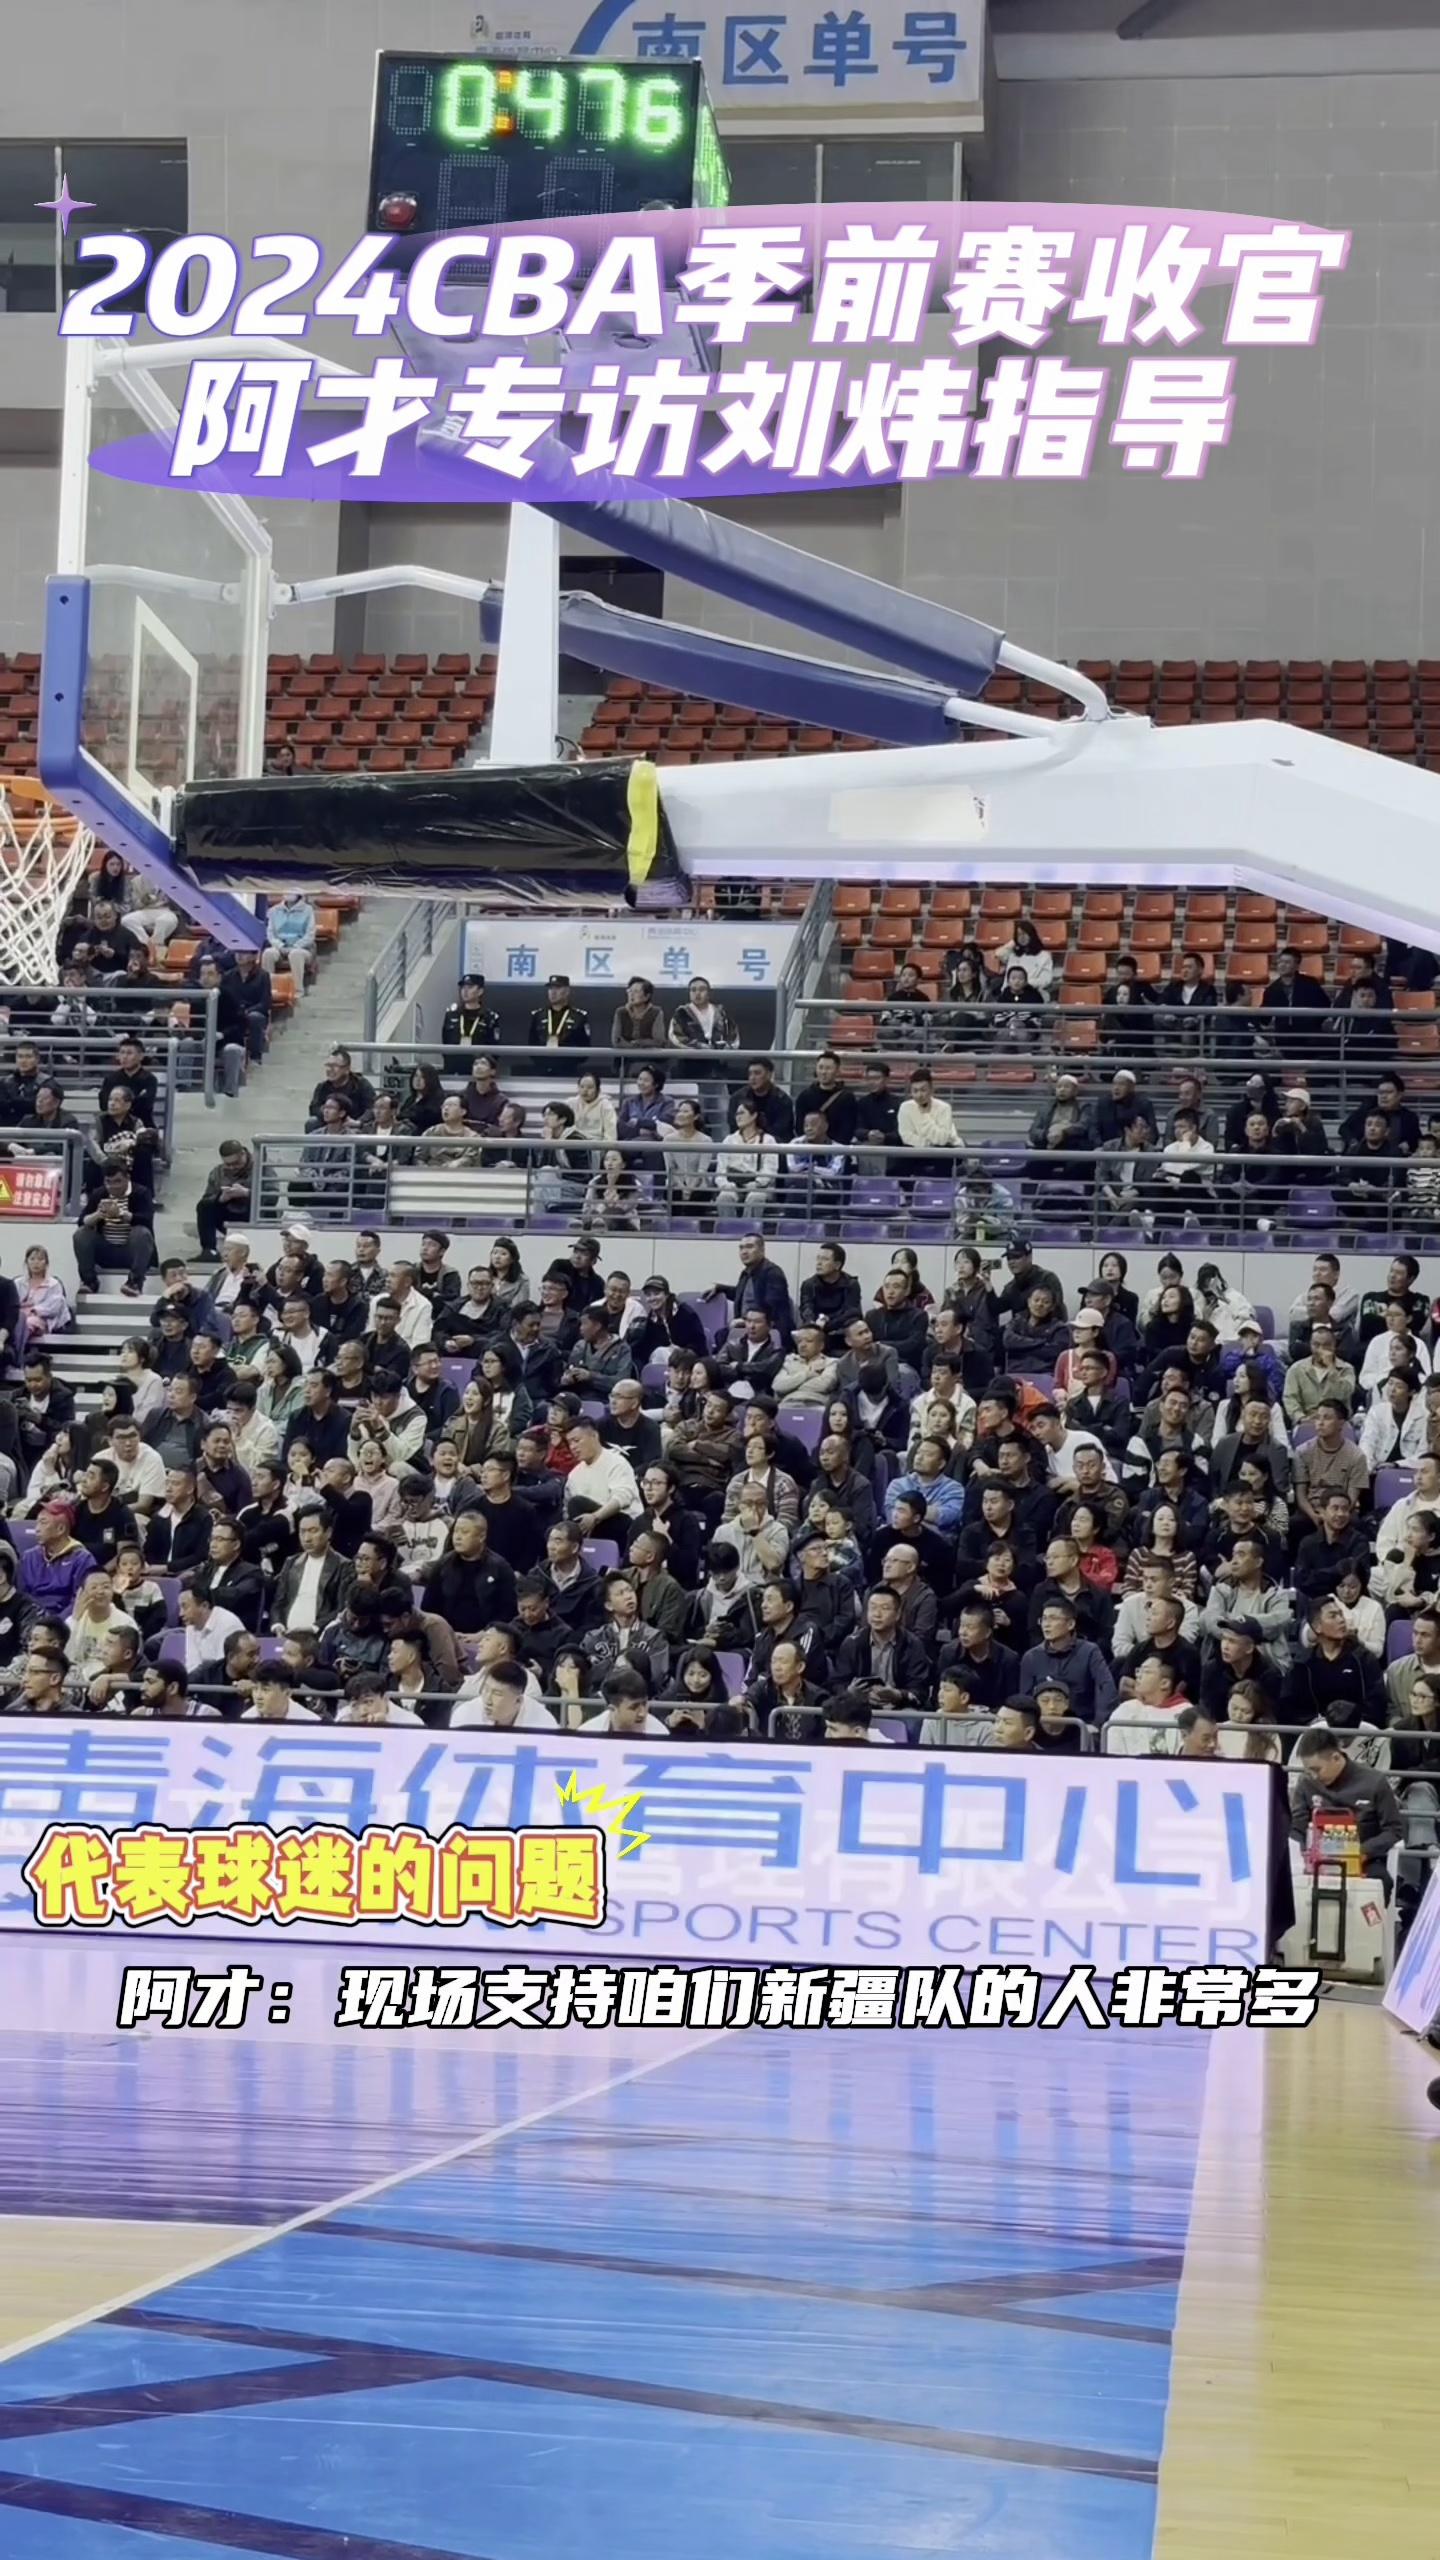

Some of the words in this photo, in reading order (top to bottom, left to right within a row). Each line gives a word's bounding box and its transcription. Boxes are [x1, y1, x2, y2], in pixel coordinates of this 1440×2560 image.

[633, 11, 967, 87] 南区单号
[506, 944, 770, 981] 南区单号
[928, 1913, 1259, 1967] CENTER
